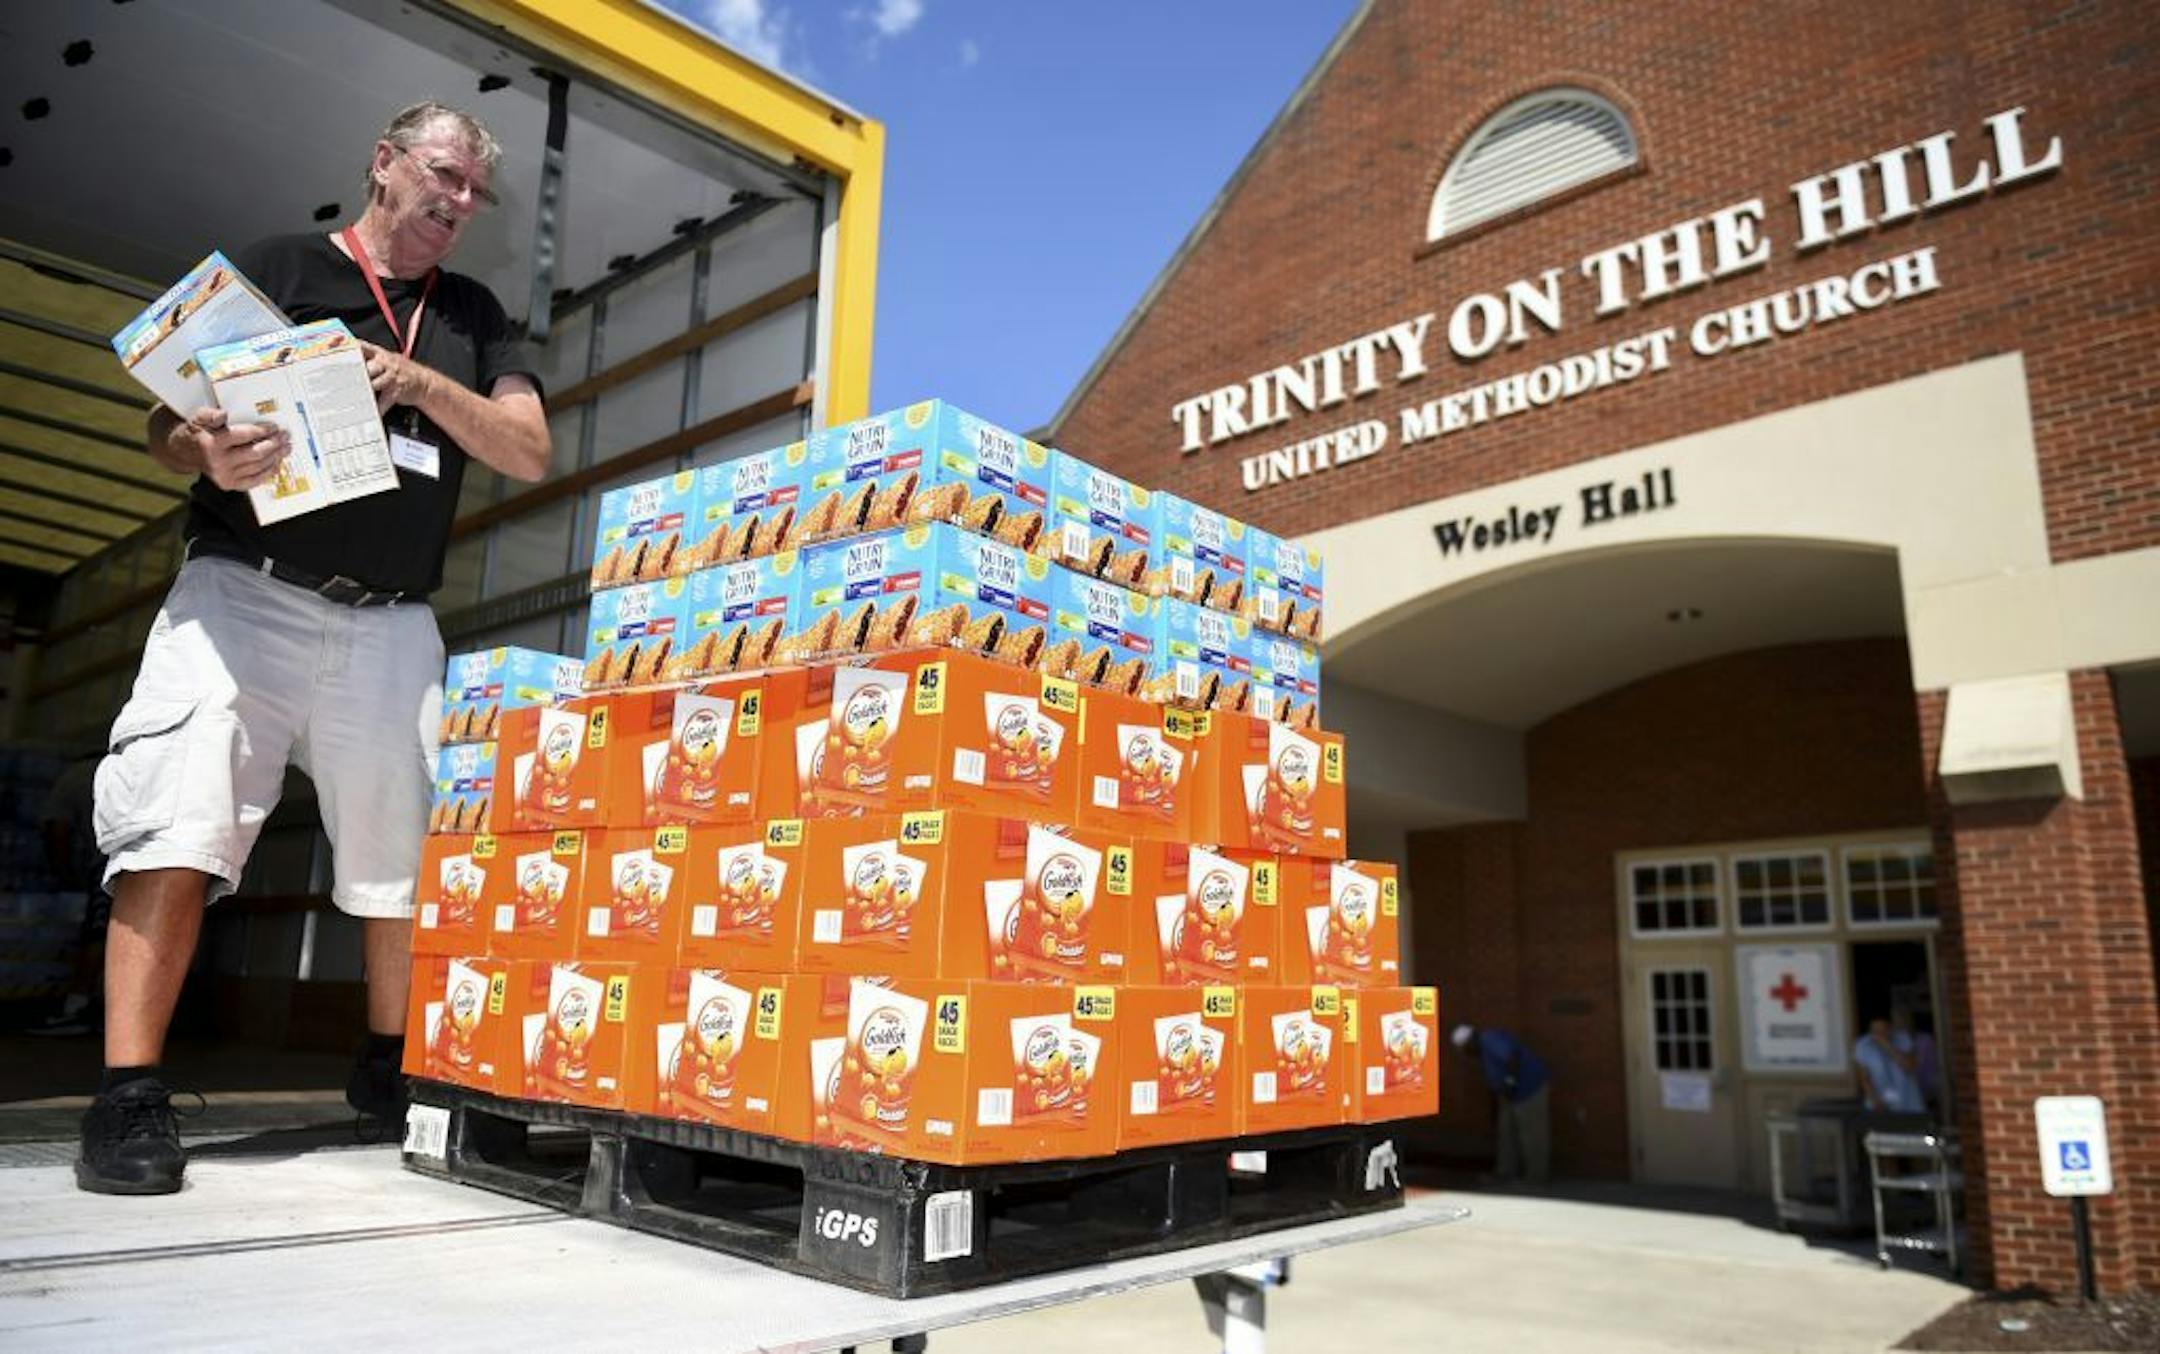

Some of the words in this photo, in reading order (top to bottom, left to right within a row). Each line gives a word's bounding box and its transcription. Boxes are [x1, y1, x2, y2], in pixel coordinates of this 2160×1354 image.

[1171, 313, 1433, 455] TRINITY
[1447, 268, 1564, 360] ON
[1582, 199, 1770, 322] THE
[1791, 106, 2063, 249] HILL
[1241, 420, 1388, 492] UNITED
[1400, 326, 1677, 447] METHODIST
[1690, 246, 1941, 359] CHURCH
[1432, 500, 1561, 559] Wesley
[1581, 469, 1678, 548] Hall
[920, 668, 938, 689] 45
[1044, 686, 1057, 704] 45
[743, 696, 758, 715] 45
[847, 698, 887, 724] Goldfish
[685, 722, 718, 745] Goldfish
[770, 826, 784, 842] 45
[903, 821, 920, 840] 45
[658, 833, 669, 849] 45
[1111, 854, 1127, 874] 45
[1044, 870, 1082, 890] Goldfish
[1257, 868, 1268, 886] 45
[1202, 887, 1233, 903] Goldfish
[610, 983, 623, 1001] 45
[761, 993, 776, 1014] 45
[939, 1001, 958, 1024] 45
[1078, 996, 1093, 1015] 45
[1206, 995, 1218, 1013] 45
[700, 1014, 733, 1032] Goldfish
[865, 1026, 906, 1047] Goldfish
[815, 1206, 879, 1247] iGPS
